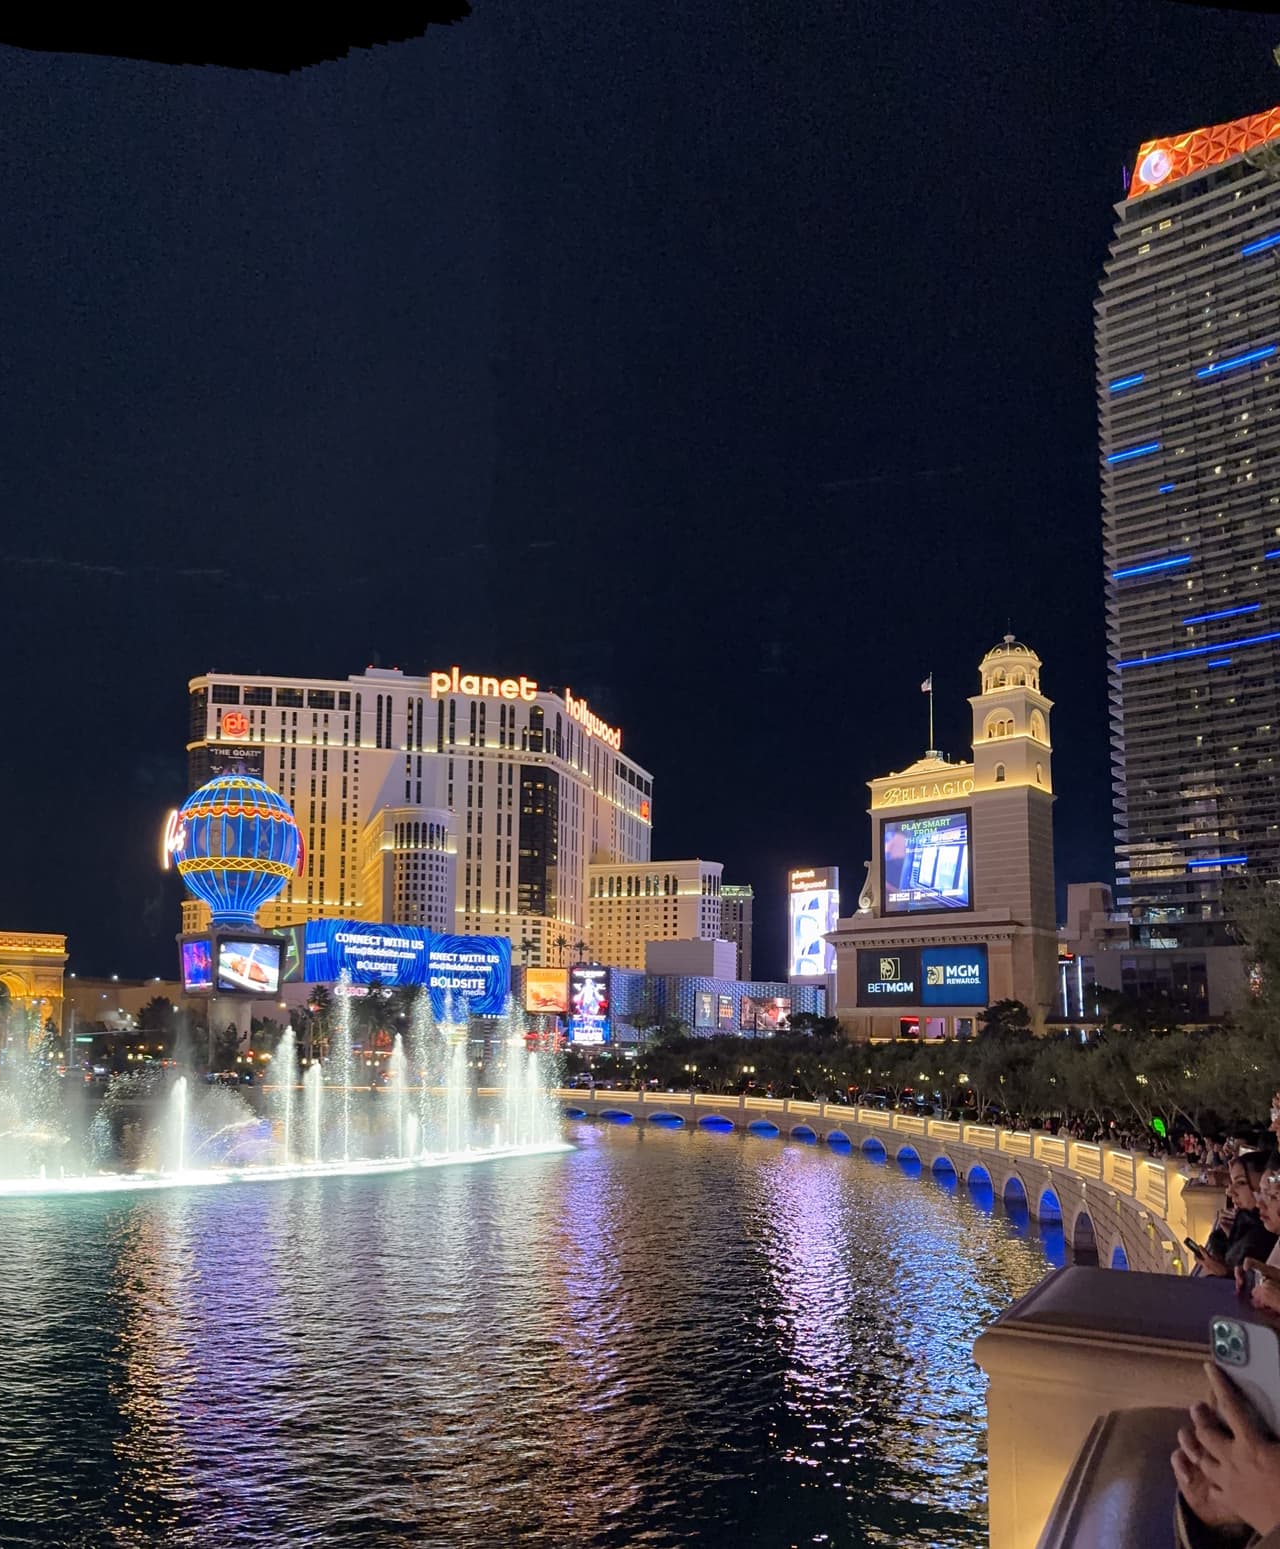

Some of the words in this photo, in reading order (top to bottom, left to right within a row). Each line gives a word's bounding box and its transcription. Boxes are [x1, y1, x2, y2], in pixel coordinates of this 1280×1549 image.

[431, 666, 538, 700] planet
[565, 687, 621, 750] hollywood
[881, 780, 974, 806] BELLAGIO
[902, 823, 921, 832] PLAY
[922, 819, 952, 829] SMART
[336, 933, 381, 946] CONNECT
[383, 936, 410, 948] WITH
[411, 940, 424, 949] US
[460, 954, 485, 963] WITH
[487, 955, 500, 964] US
[357, 961, 398, 971] BOLDSITE
[946, 965, 979, 977] MGM
[430, 976, 486, 989] BOLDSITE
[867, 983, 914, 993] BETMGM
